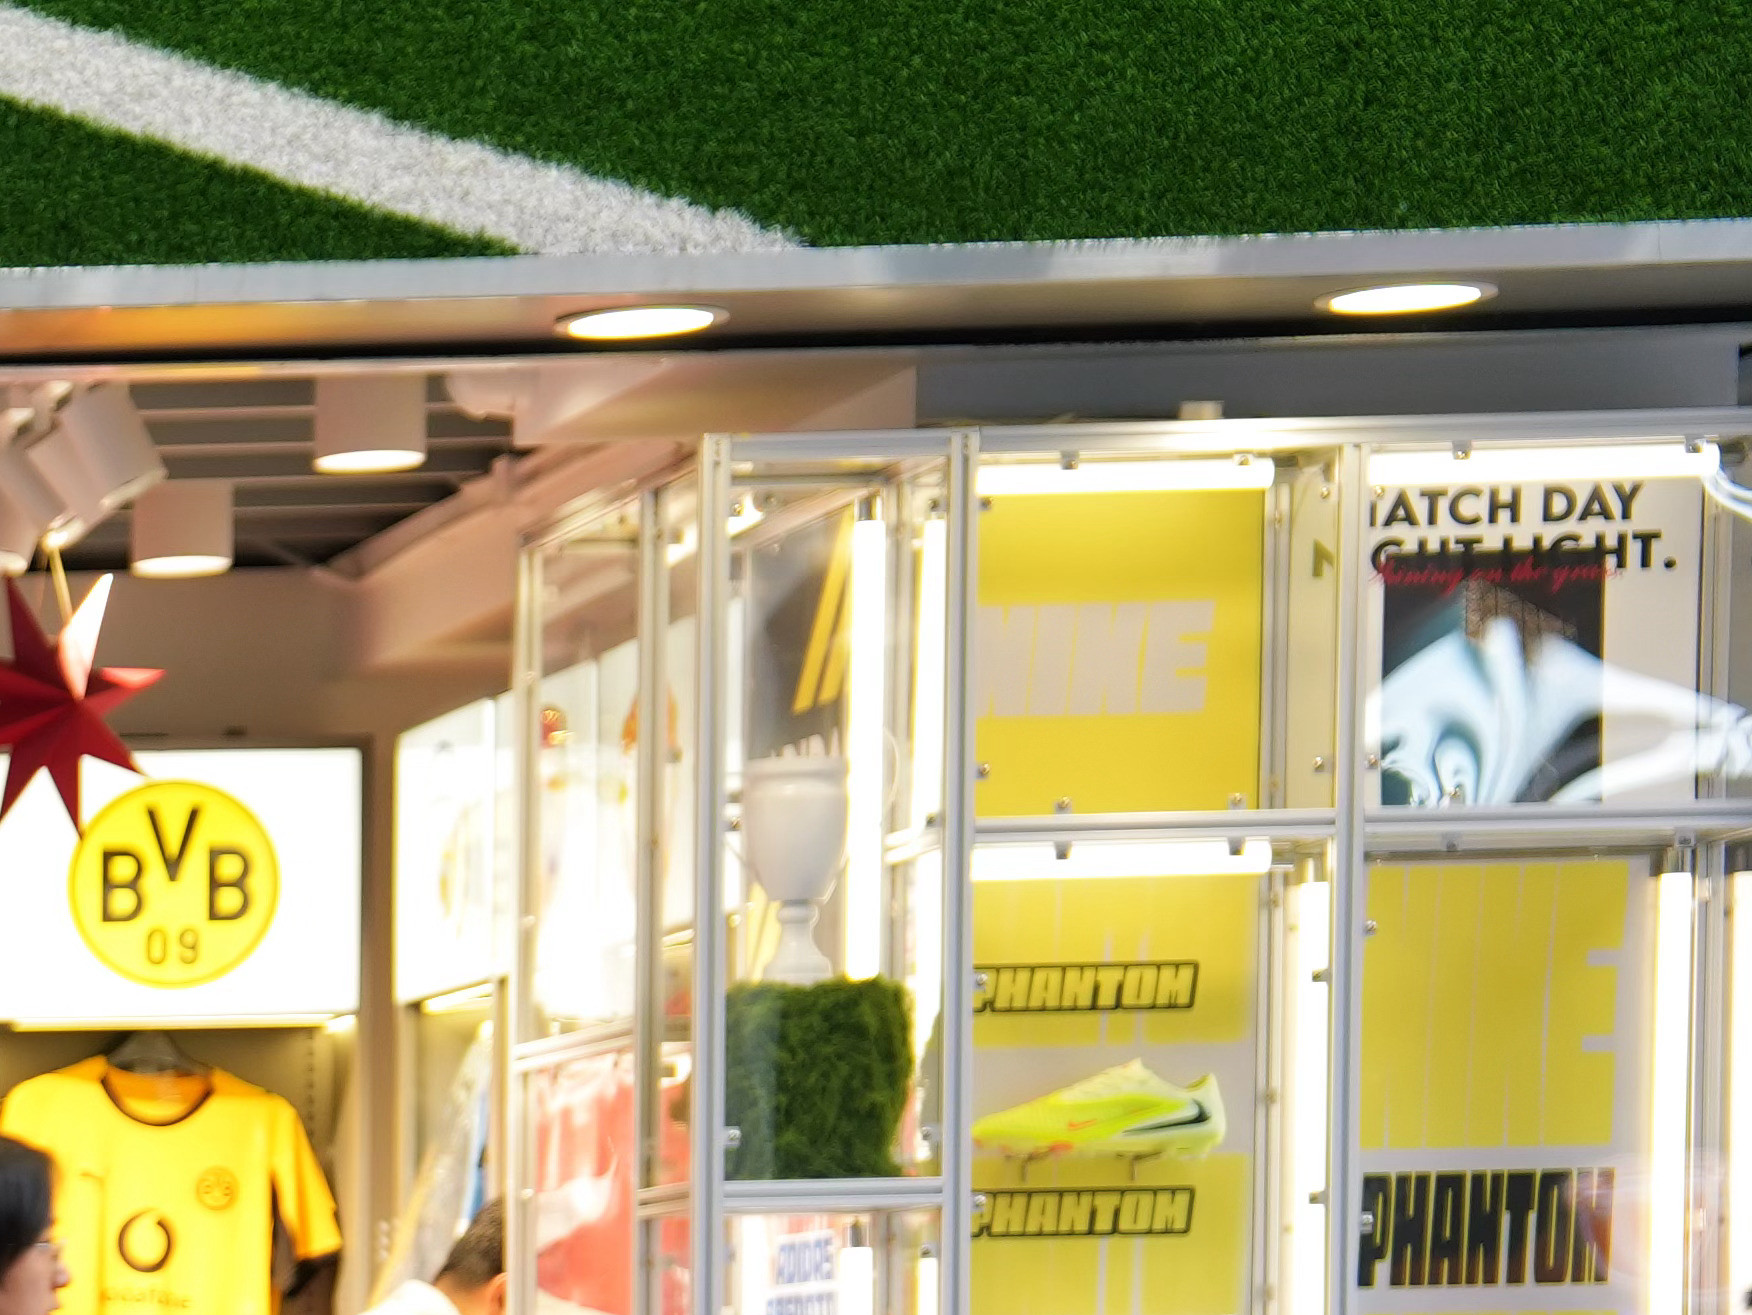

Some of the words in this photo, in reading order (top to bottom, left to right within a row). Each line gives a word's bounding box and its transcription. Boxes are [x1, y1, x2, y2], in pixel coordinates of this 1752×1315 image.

[1543, 482, 1644, 525] DAY
[976, 599, 1218, 718] NIKE
[101, 806, 253, 923] BVB
[146, 928, 199, 965] 09
[1357, 1166, 1617, 1288] PHANTOM
